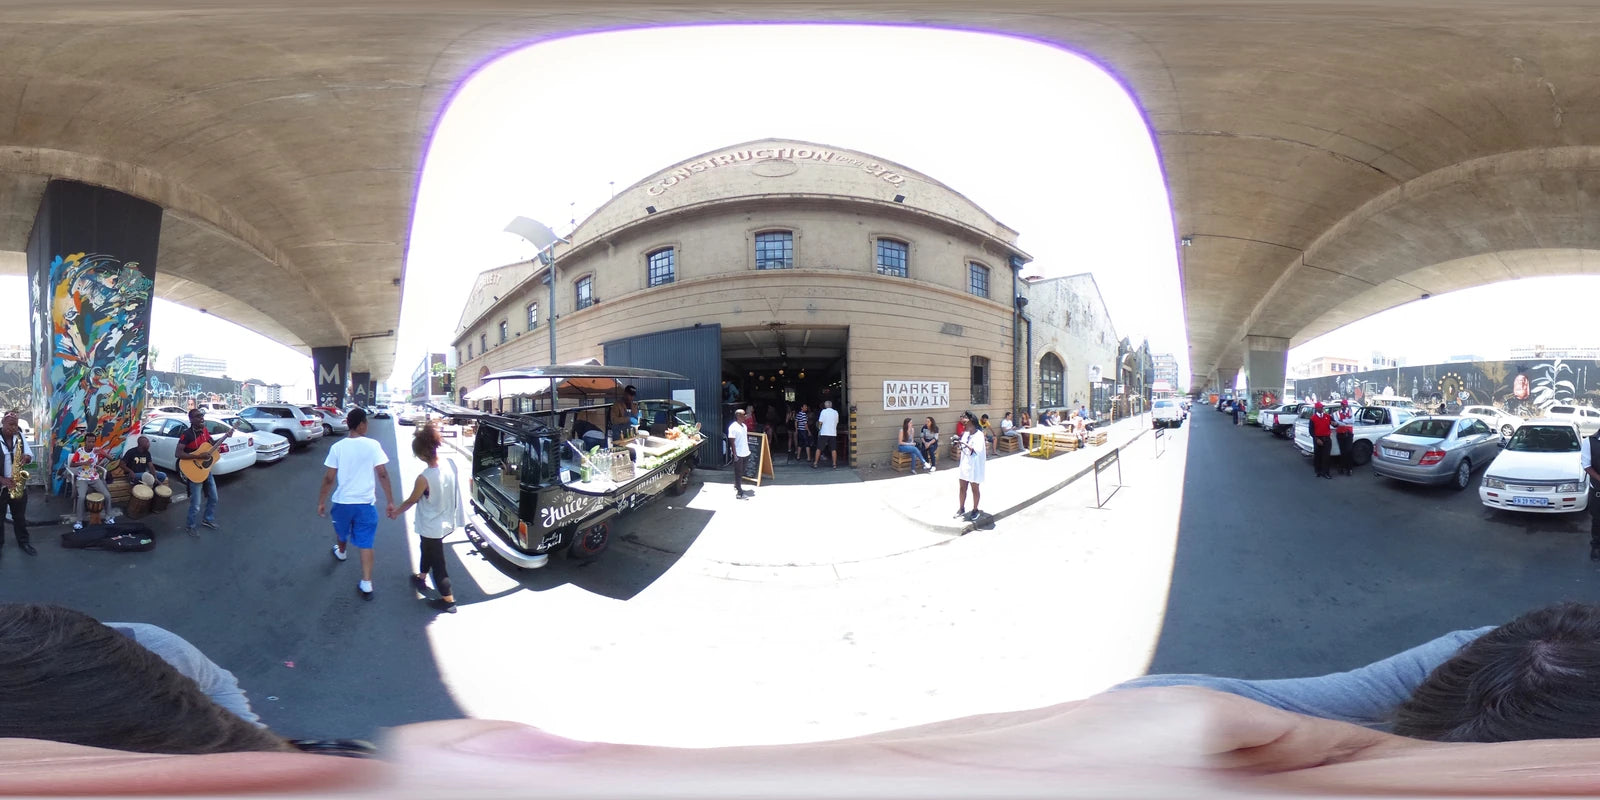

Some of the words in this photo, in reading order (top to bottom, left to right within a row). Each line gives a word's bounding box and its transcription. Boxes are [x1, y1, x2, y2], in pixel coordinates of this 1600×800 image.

[646, 148, 834, 196] CONSTRUCTION
[319, 363, 340, 385] M
[356, 384, 366, 395] A
[886, 383, 947, 394] MARKET
[909, 395, 949, 406] MAIN
[541, 497, 589, 528] Juice
